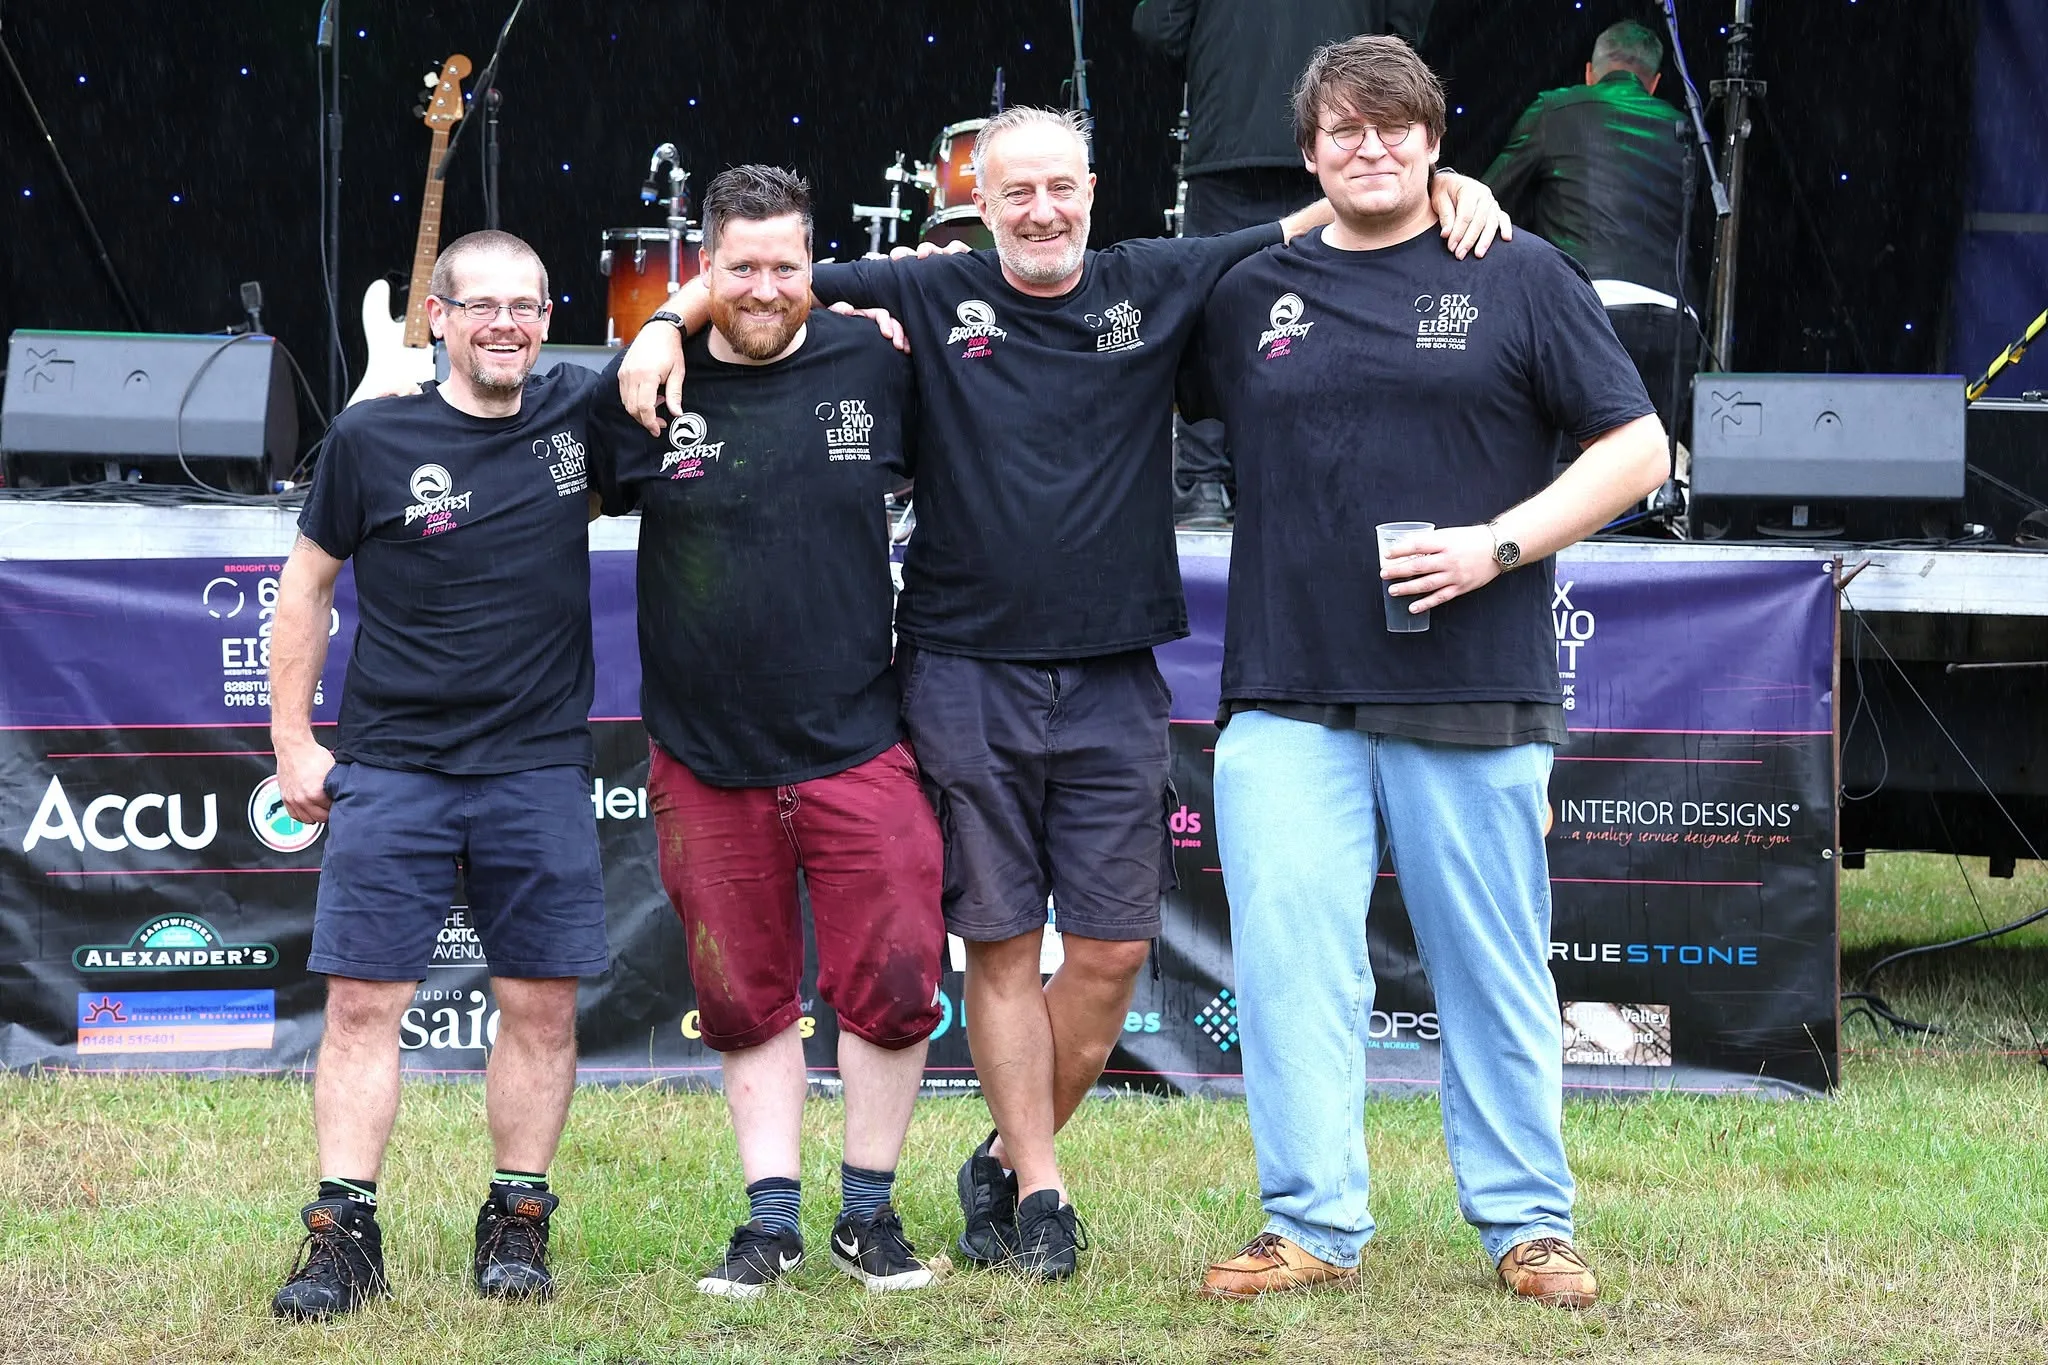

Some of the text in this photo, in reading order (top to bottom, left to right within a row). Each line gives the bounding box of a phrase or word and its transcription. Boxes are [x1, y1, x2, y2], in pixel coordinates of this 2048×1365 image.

[1440, 294, 1471, 307] 6IX
[1110, 309, 1142, 331] 2WO
[1438, 306, 1479, 320] 2WO
[1418, 320, 1473, 333] EI8HT
[967, 336, 989, 347] 2026
[1097, 324, 1139, 348] EI8HT
[840, 400, 866, 414] 6IX
[841, 414, 874, 428] 2WO
[551, 430, 576, 449] 6IX
[826, 428, 871, 443] EI8HT
[557, 442, 585, 461] 2WO
[660, 441, 726, 472] BROCKFEST
[549, 456, 586, 479] EI8HT
[677, 458, 703, 470] 2026
[404, 491, 473, 526] BROCKFEST
[426, 510, 452, 524] 2026
[1561, 799, 1674, 825] INTERIOR
[1585, 827, 1633, 847] quality
[1638, 830, 1679, 843] service
[1684, 830, 1741, 849] designed
[1743, 829, 1764, 849] for
[1764, 834, 1791, 850] you
[140, 918, 213, 942] SANDWICHES
[84, 948, 268, 967] ALEXANDER'S
[432, 944, 486, 960] AVENU
[1548, 942, 1759, 966] RUESTONE
[415, 990, 463, 1001] TUDIO
[1621, 1009, 1668, 1027] Valley
[82, 1034, 176, 1047] 01484 515401
[1383, 1041, 1420, 1051] WORKERS
[1566, 1048, 1626, 1066] Granite
[949, 1079, 967, 1087] FOR
[967, 1079, 981, 1087] OU
[519, 1202, 541, 1213] JACK
